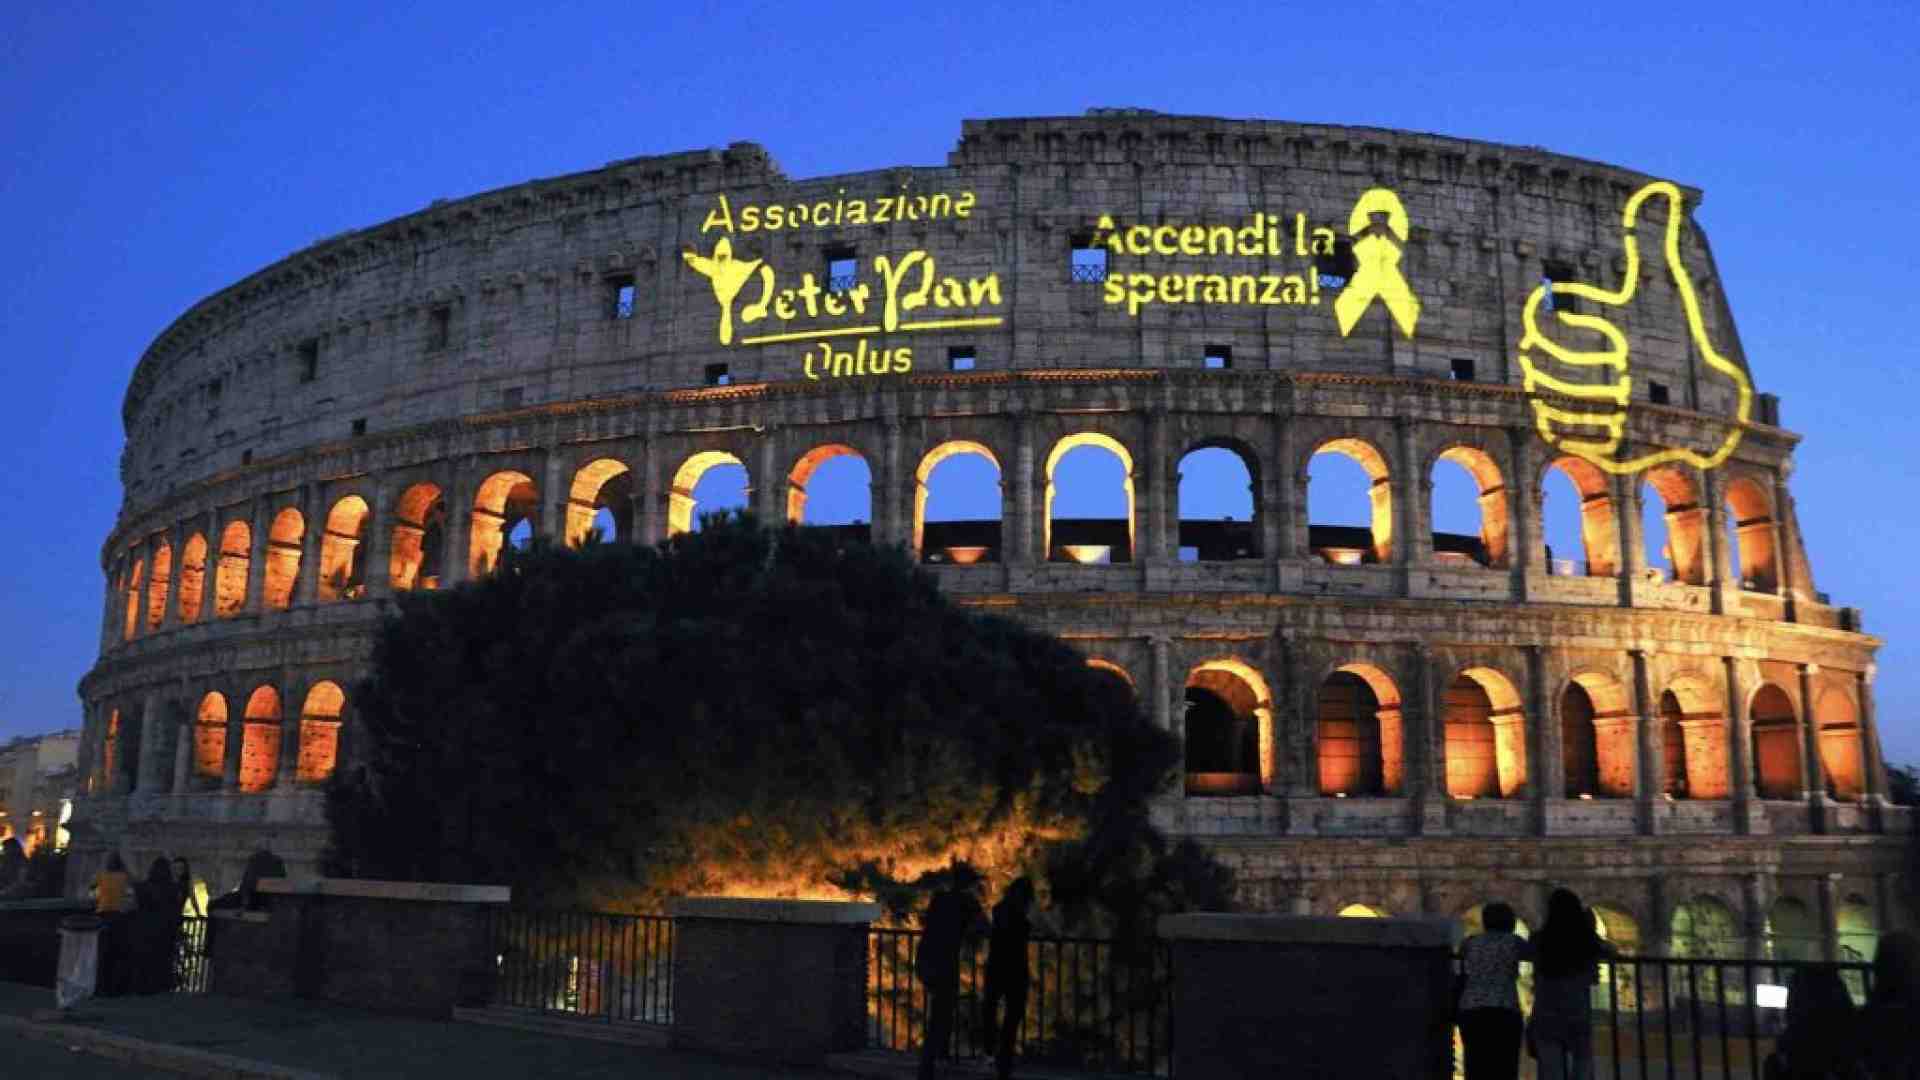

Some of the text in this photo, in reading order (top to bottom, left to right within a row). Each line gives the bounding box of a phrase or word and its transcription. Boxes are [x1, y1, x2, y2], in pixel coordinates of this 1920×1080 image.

[701, 183, 977, 234] Associazione
[1091, 211, 1336, 257] Accendi la
[682, 236, 1002, 346] Peter Pan
[1103, 265, 1321, 317] speranza!
[803, 338, 914, 381] Onlus
